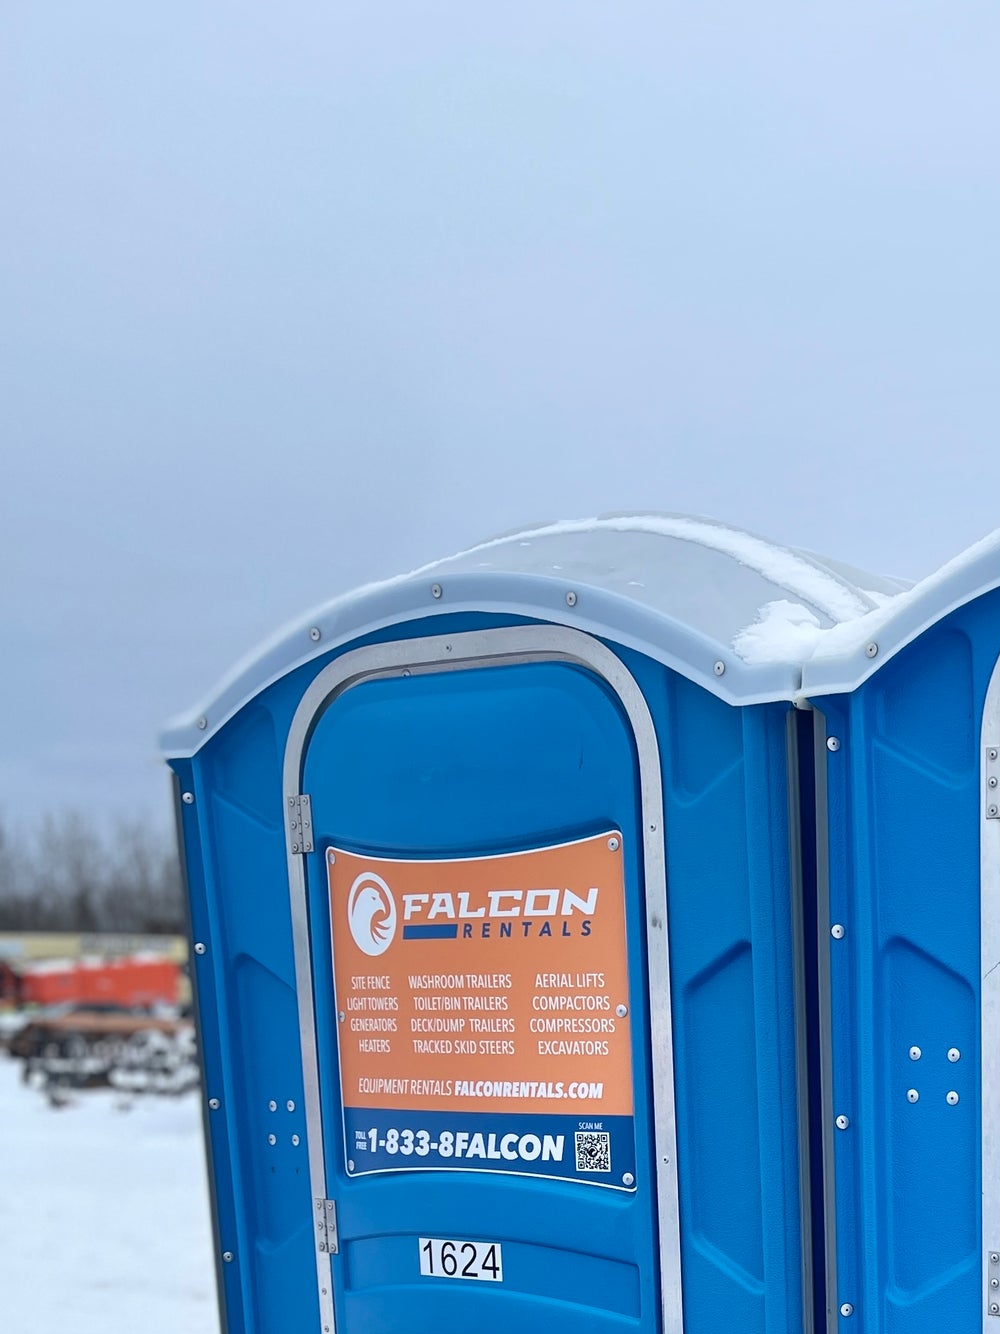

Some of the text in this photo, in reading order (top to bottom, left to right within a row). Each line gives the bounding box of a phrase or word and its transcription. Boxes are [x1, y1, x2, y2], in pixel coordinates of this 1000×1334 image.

[402, 888, 598, 921] FALCON
[462, 920, 593, 938] RENTALS
[351, 975, 391, 990] SITE FENCE
[408, 974, 512, 990] WASHROOM TRAILERS
[535, 973, 605, 988] AERIAL LIFTS
[347, 997, 399, 1011] LIGHT TOWERS
[413, 996, 508, 1011] TOILET/BIN TRAILERS
[532, 996, 610, 1011] COMPACTORS
[350, 1018, 397, 1032] GENERATORS
[411, 1018, 515, 1033] DECK/DUMP TRAILERS
[529, 1018, 615, 1033] COMPRESSORS
[359, 1039, 391, 1053] HEATERS
[412, 1039, 515, 1055] TRACKED SKID STEERS
[538, 1040, 609, 1055] EXCAVATORS
[358, 1077, 603, 1099] EQUIPMENT RENTALS FALCONRENTALS.COM
[578, 1122, 603, 1131] SCAN ME
[355, 1131, 366, 1140] TOLL
[356, 1141, 367, 1150] FREE
[368, 1128, 565, 1161] 1-833-8FALCON
[423, 1240, 500, 1280] 1624
